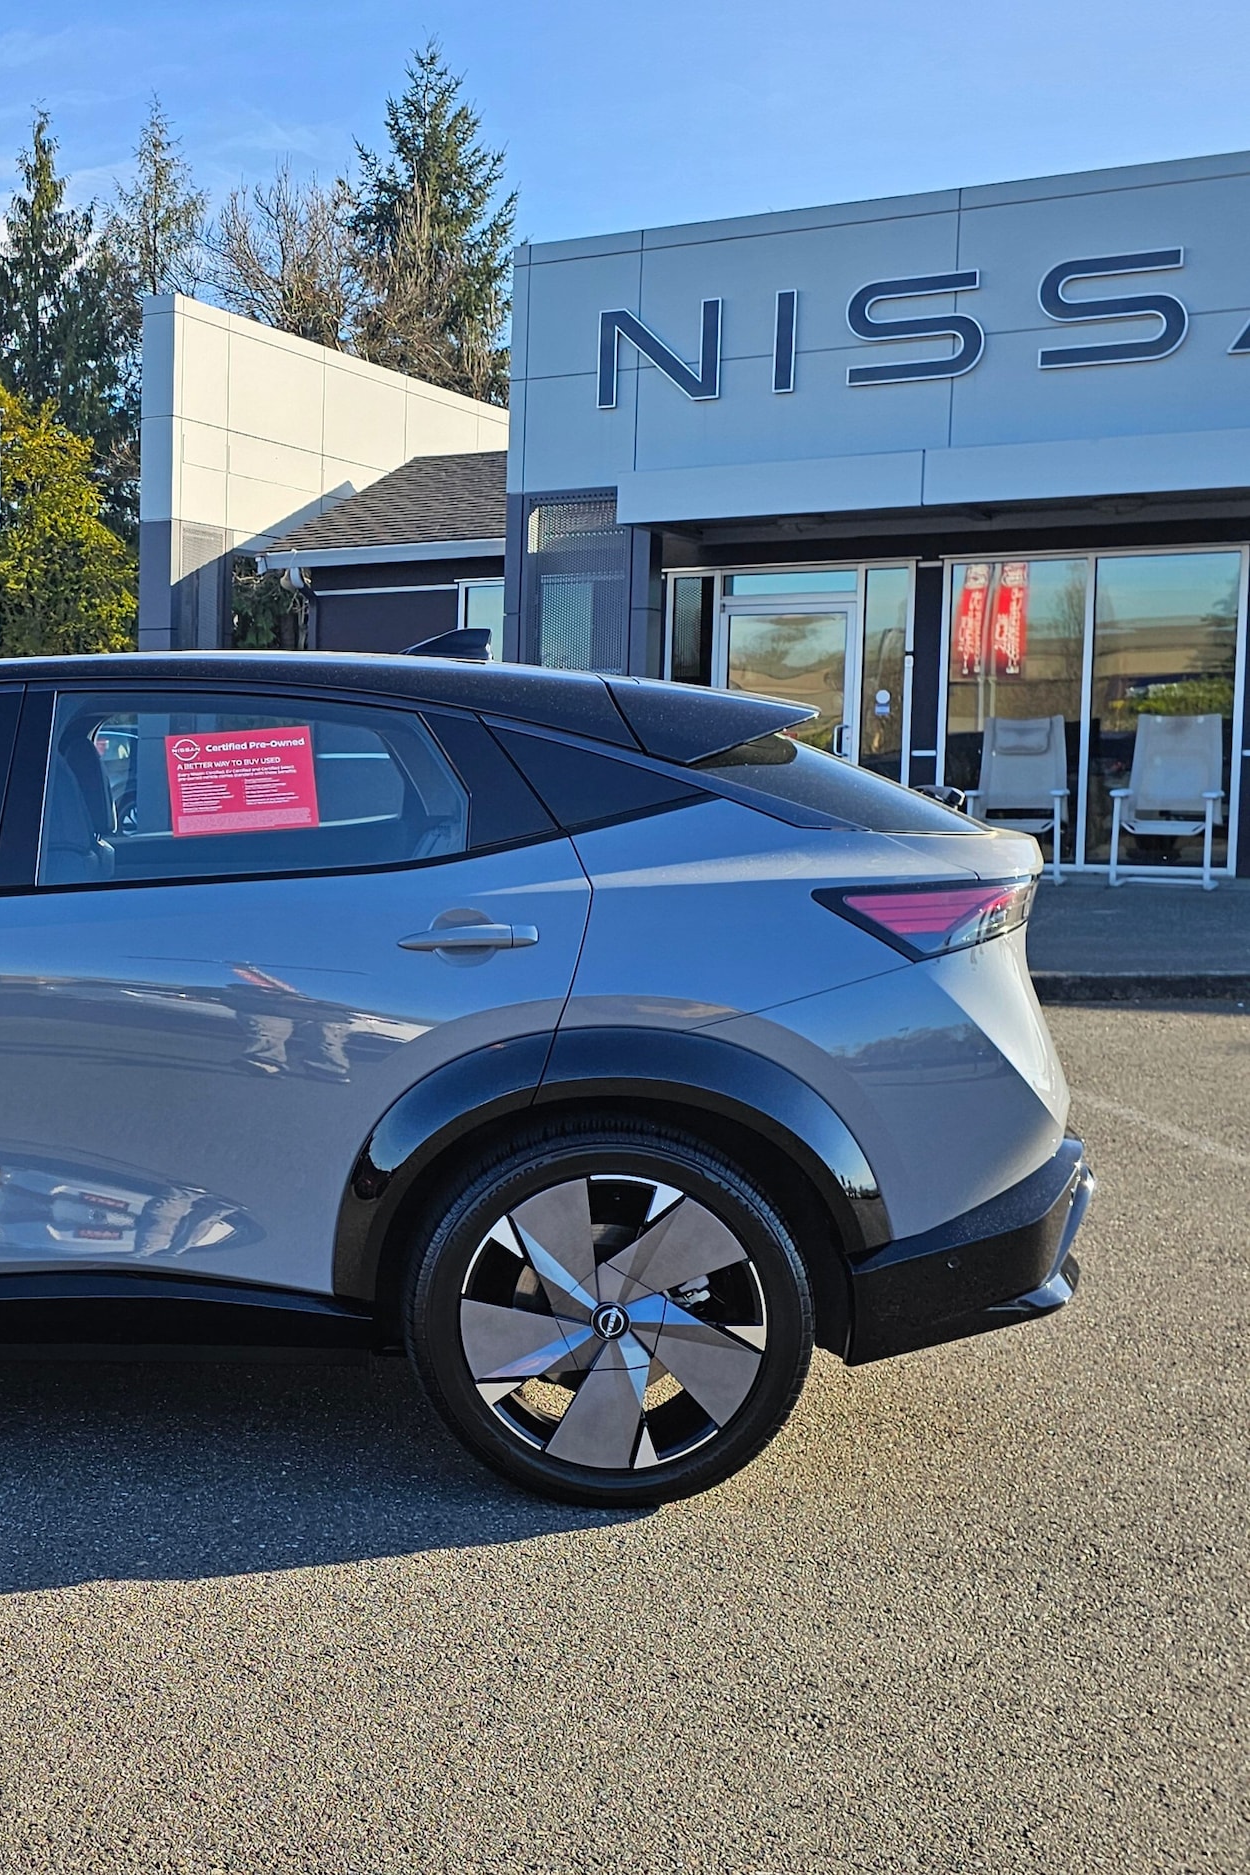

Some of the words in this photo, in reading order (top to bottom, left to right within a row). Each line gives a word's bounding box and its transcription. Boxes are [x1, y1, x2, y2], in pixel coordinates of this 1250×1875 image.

[596, 246, 1250, 409] NISS
[205, 741, 247, 753] Certified
[249, 737, 306, 750] Pre-Owned
[177, 763, 184, 771] A
[184, 761, 213, 771] BETTER
[214, 760, 231, 768] WAY
[231, 759, 243, 767] TO
[243, 758, 260, 766] BUY
[260, 756, 282, 765] USED
